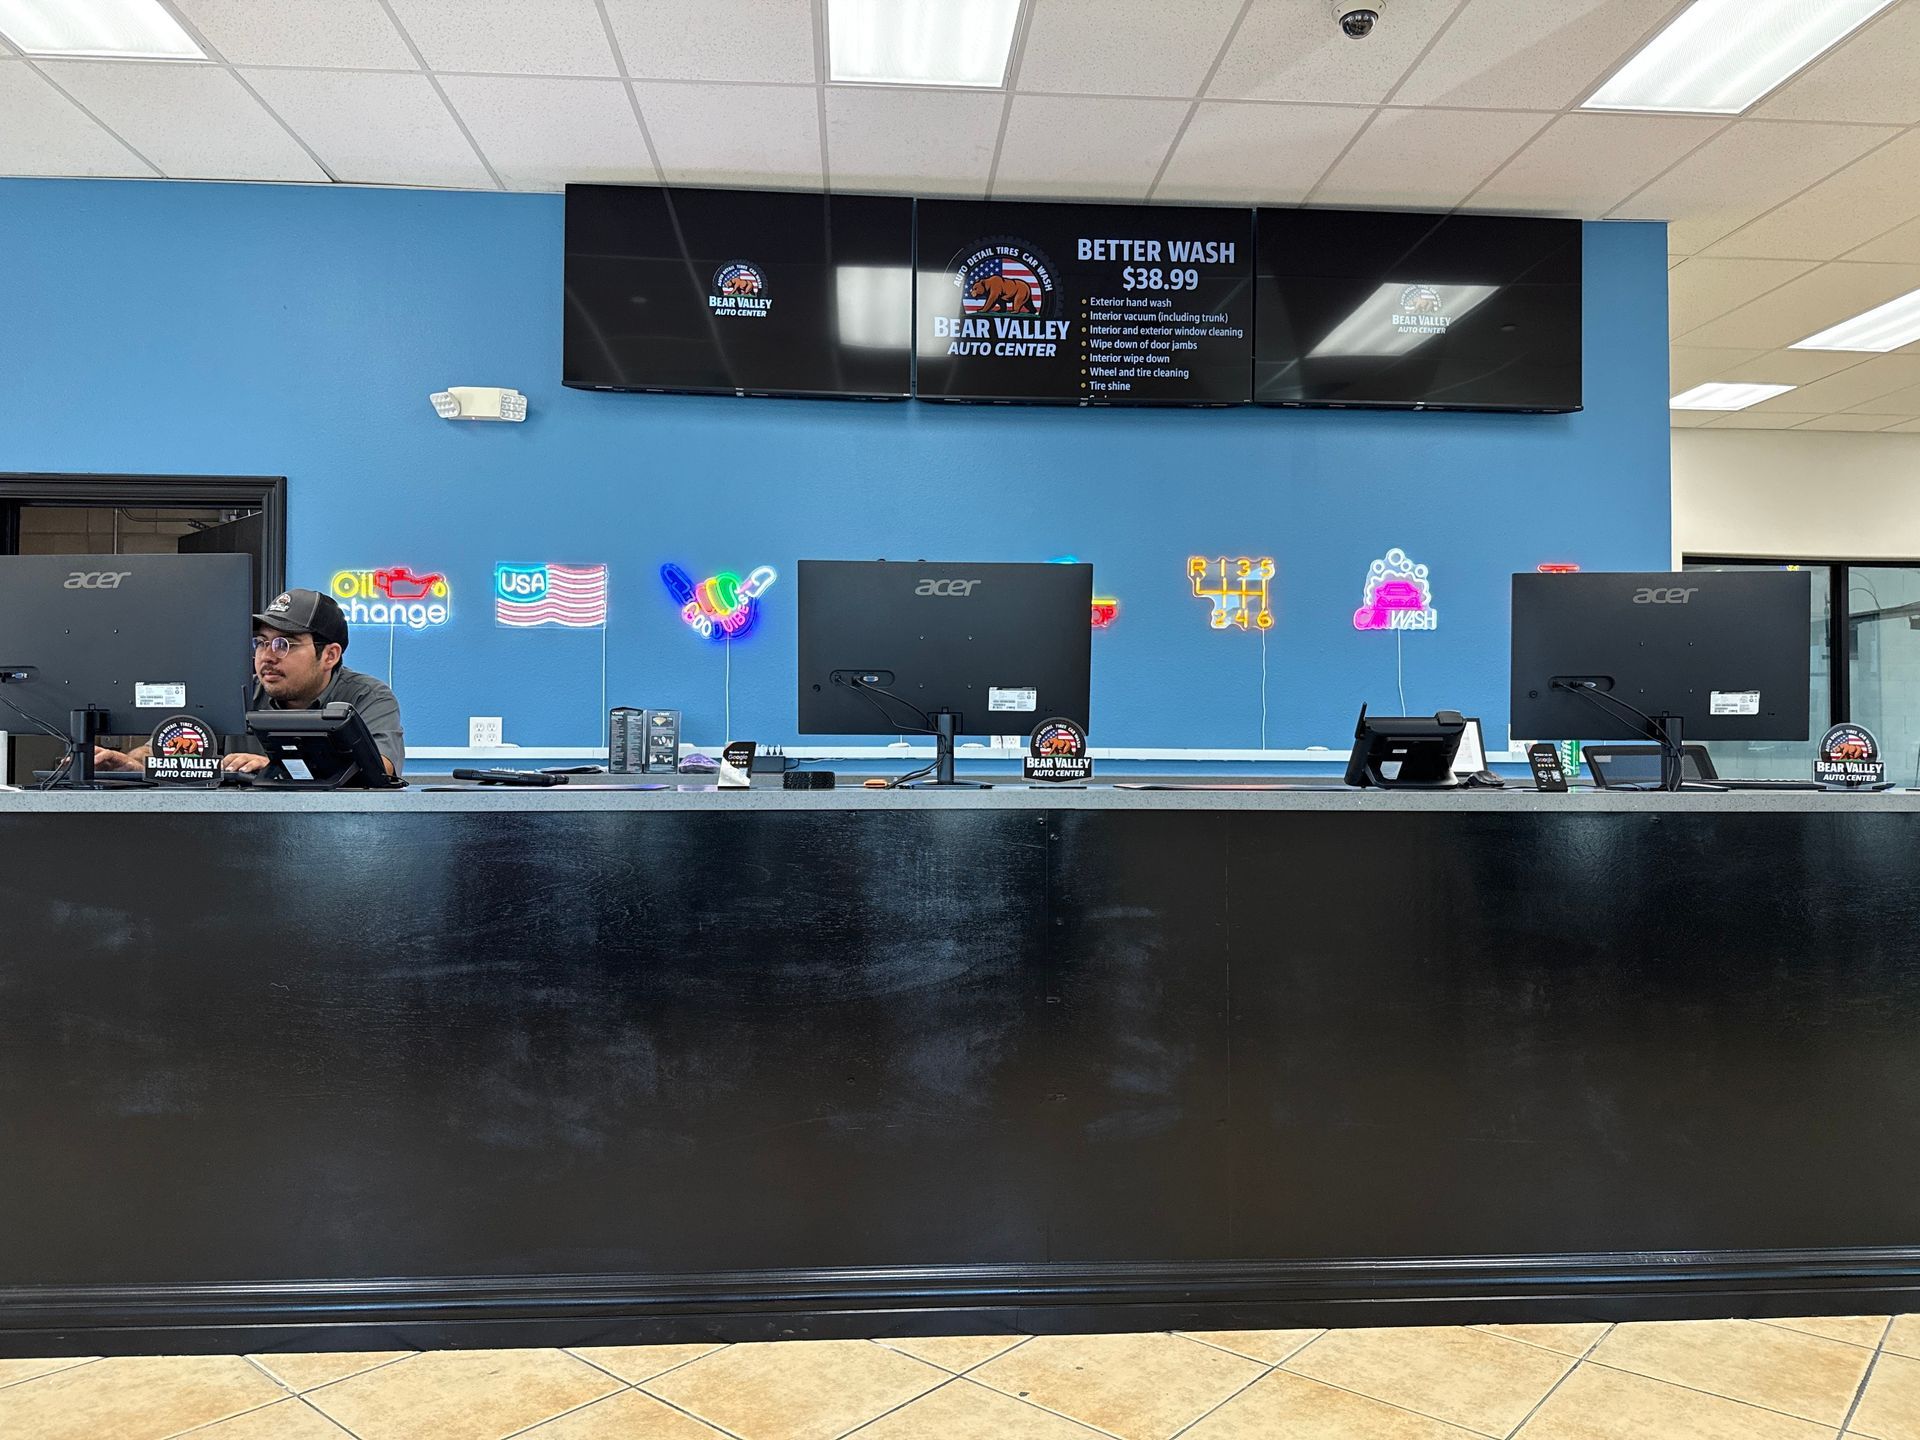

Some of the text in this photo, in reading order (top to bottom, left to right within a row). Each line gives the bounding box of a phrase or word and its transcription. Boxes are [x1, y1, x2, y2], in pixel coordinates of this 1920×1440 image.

[1078, 238, 1235, 264] BETTER WASH
[953, 246, 1054, 292] AUTO DETAIL TIRES CAR WASH
[1123, 266, 1199, 291] $38.99
[709, 295, 772, 310] BEAR VALLEY
[1090, 297, 1172, 308] Exterior hand wash
[715, 308, 767, 317] AUTO CENTER
[1090, 311, 1229, 324] Interior vacuum (including trunk)
[934, 316, 1071, 340] BEAR VALLEY
[1392, 314, 1451, 327] BEAR VALLEY
[1090, 324, 1243, 339] Interior and exterior window cleaning
[947, 341, 1057, 357] AUTO CENTER
[1090, 339, 1198, 351] Wipe down of door jambs
[1090, 353, 1170, 364] Interior wipe down
[1090, 367, 1190, 380] Wheel and tire cleaning
[1090, 381, 1131, 391] Tire shine
[1191, 558, 1207, 577] R
[1236, 558, 1250, 577] 3
[1260, 558, 1273, 577] 5
[63, 571, 132, 589] acer
[333, 571, 379, 598] Oil
[501, 572, 546, 595] USA
[914, 578, 982, 597] acer
[1632, 587, 1699, 604] acer
[1214, 609, 1272, 628] 2 4 6
[1391, 609, 1437, 629] WASH
[148, 757, 219, 769] BEAR VALLEY
[1026, 757, 1090, 769] BEAR VALLEY
[1816, 761, 1883, 774] BEAR VALLEY
[154, 770, 214, 778] AUTO CENTER
[1032, 769, 1085, 777] AUTO CENTER
[1846, 774, 1877, 782] CENTER
